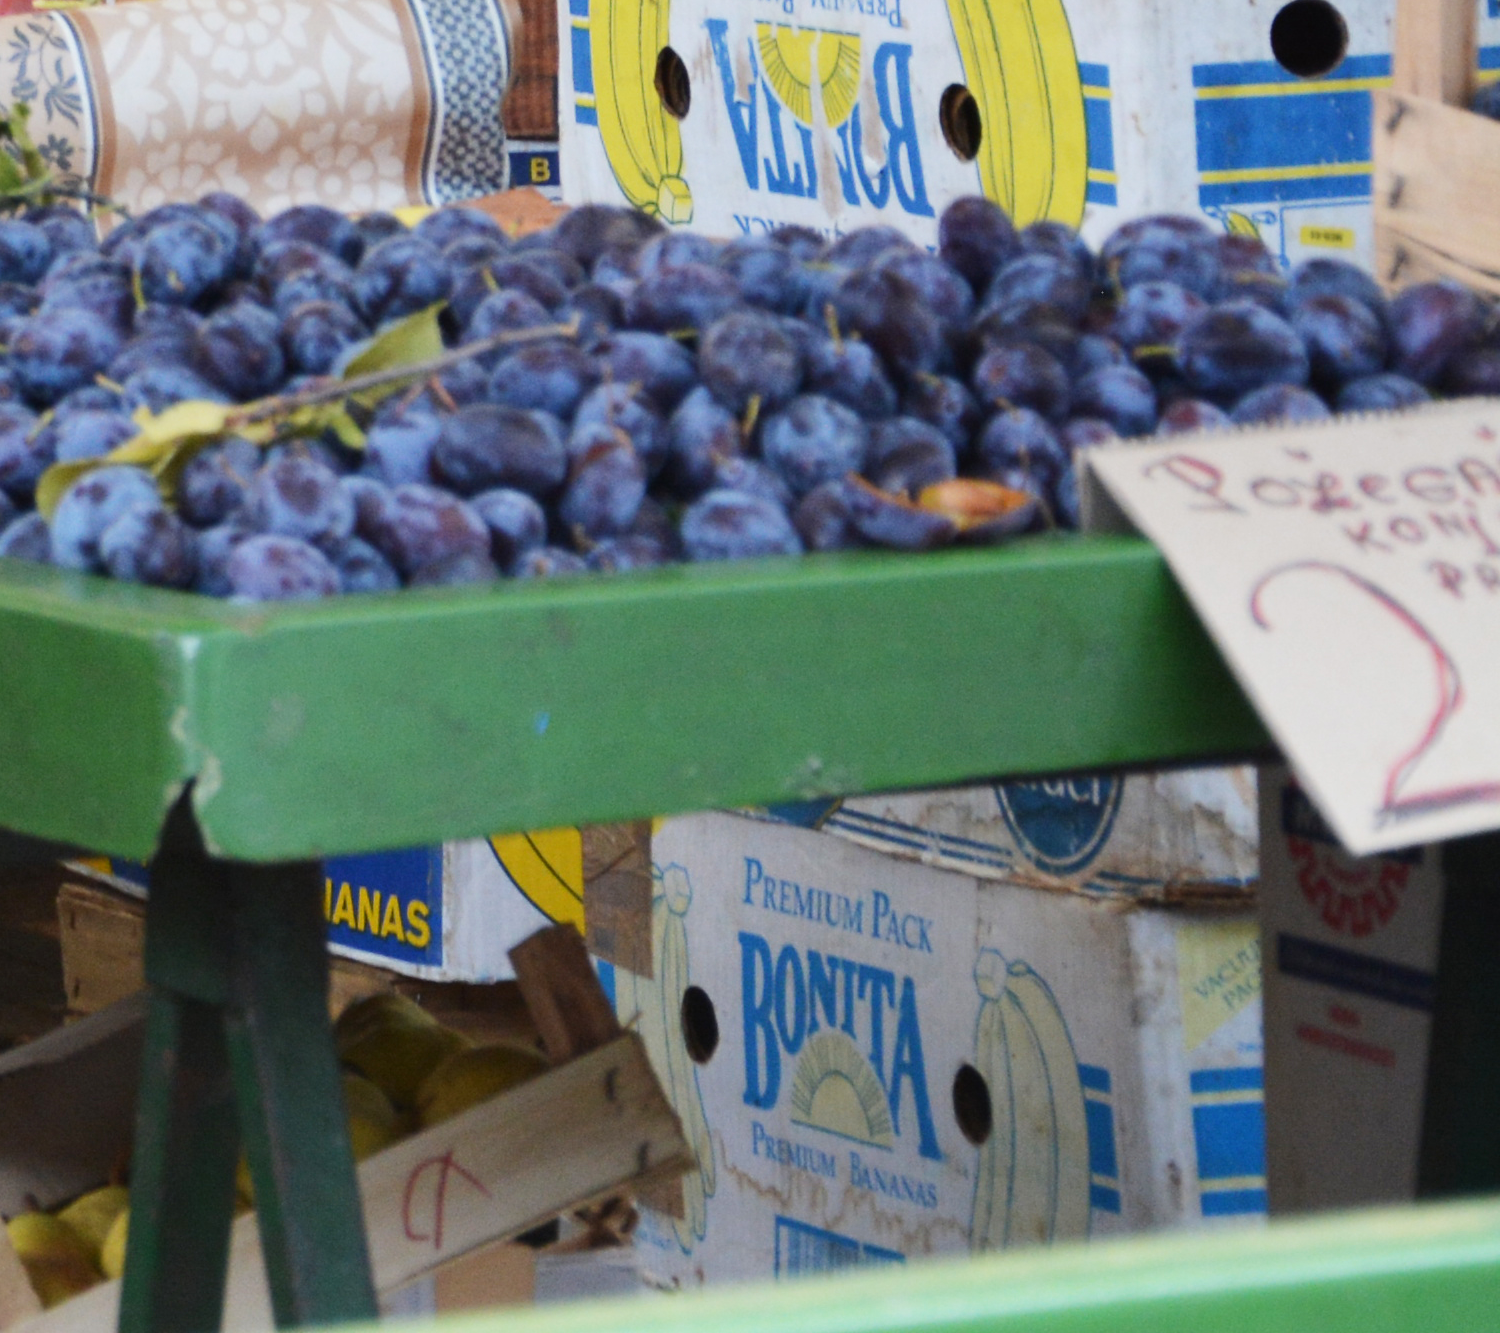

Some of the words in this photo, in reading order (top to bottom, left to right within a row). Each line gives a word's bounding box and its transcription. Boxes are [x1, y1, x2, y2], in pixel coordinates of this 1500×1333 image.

[1250, 560, 1500, 833] 2
[325, 876, 431, 949] ANAS
[743, 855, 865, 936] PREMIUM
[870, 883, 935, 957] PACK
[737, 928, 946, 1165] BONITA
[751, 1123, 838, 1182] PREMIUM
[848, 1152, 939, 1213] BANANAS
